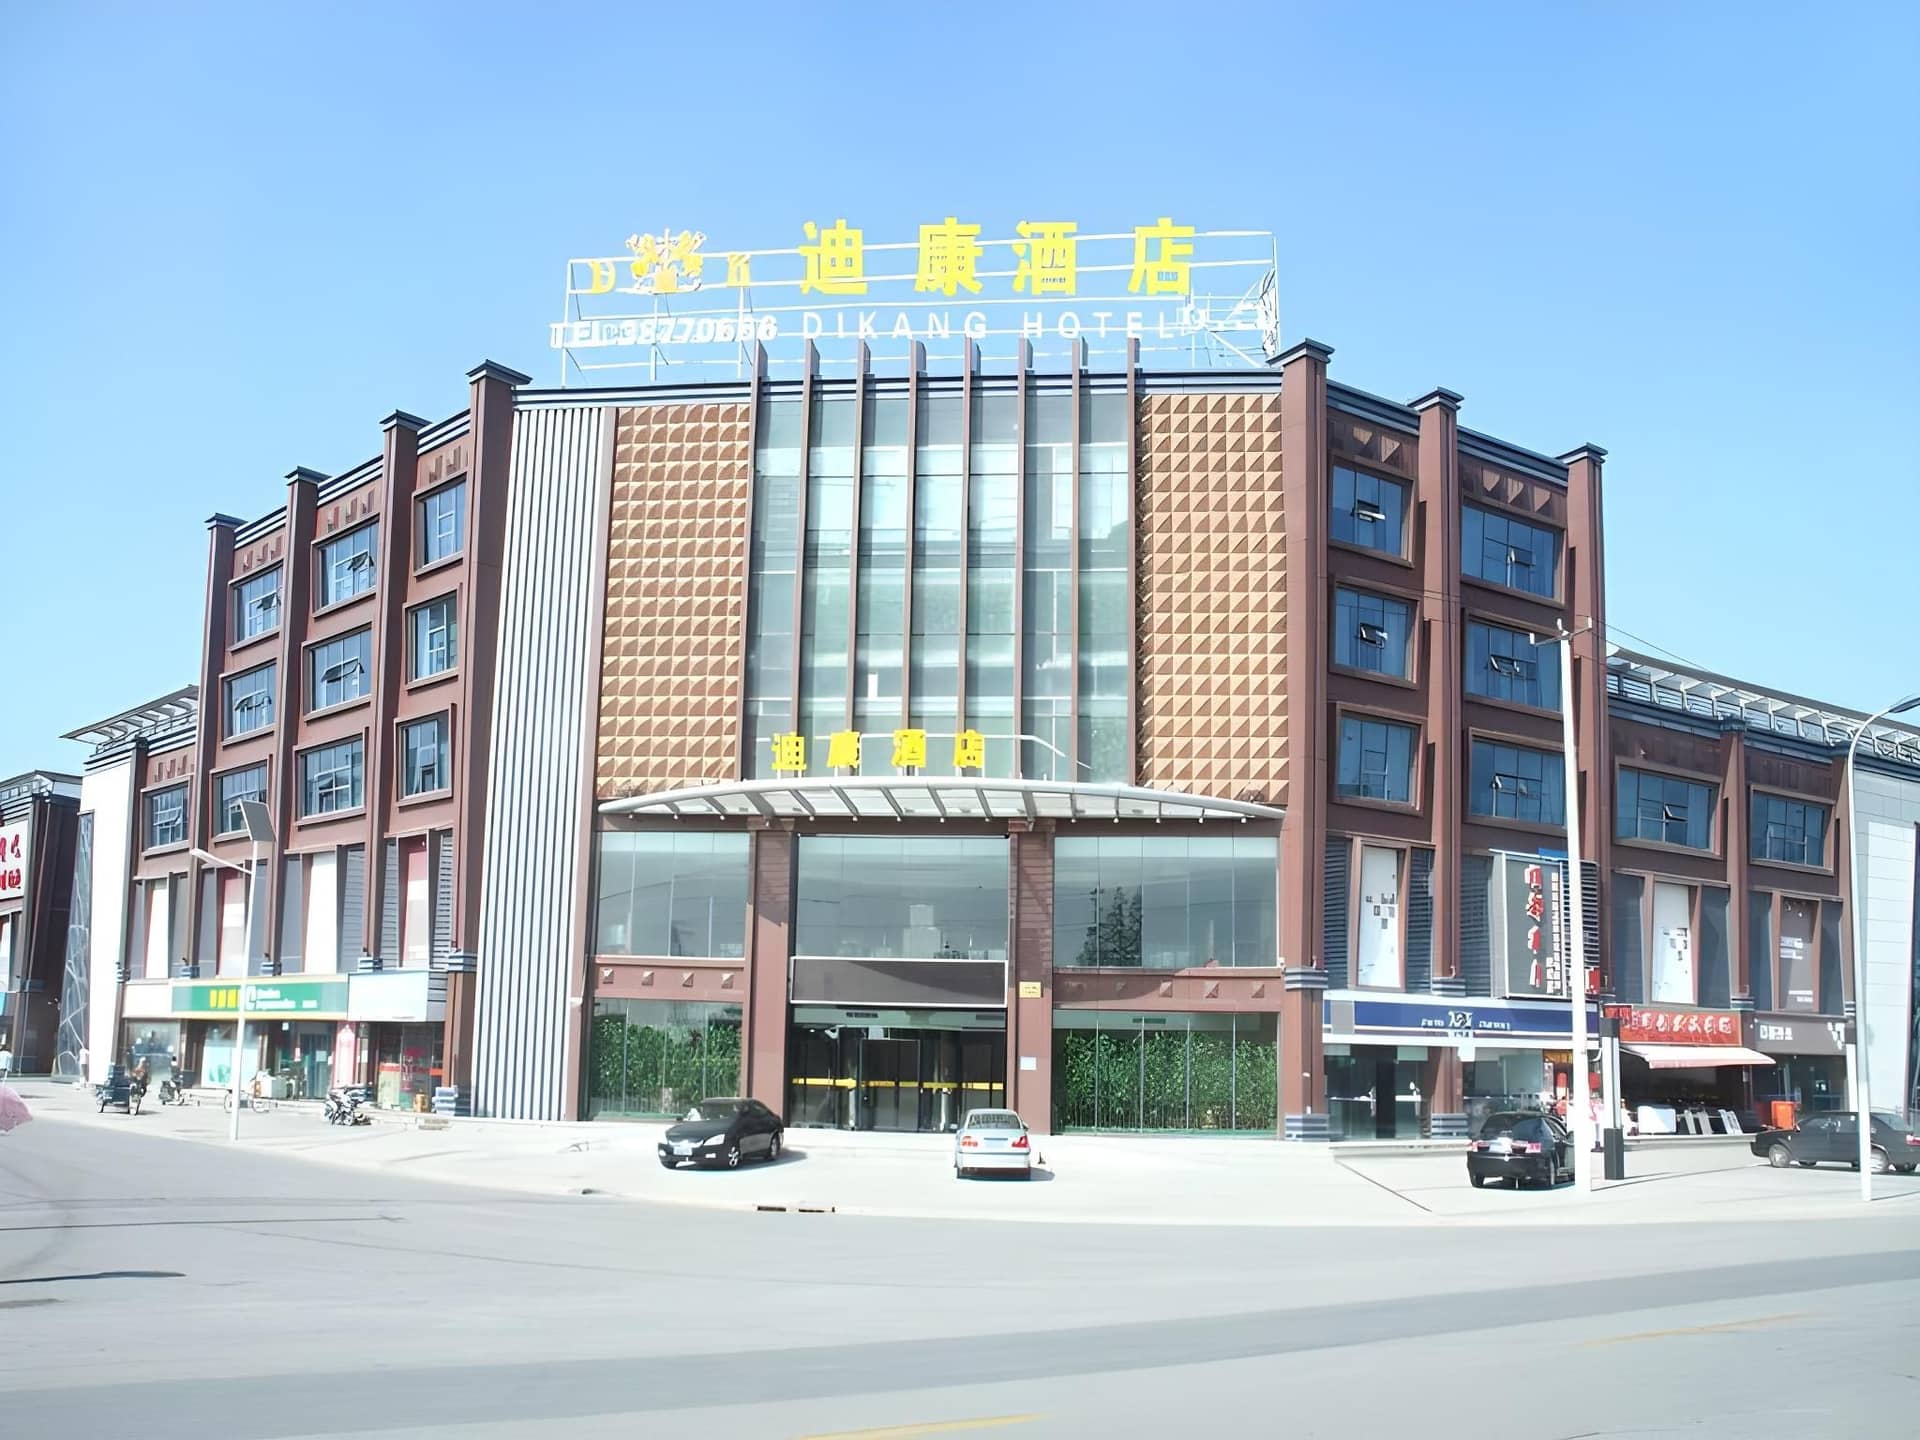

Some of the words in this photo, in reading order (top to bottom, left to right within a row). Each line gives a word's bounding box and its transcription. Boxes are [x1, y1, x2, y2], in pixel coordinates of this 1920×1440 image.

[799, 217, 1195, 297] 迪康酒店
[803, 311, 987, 339] DIKANG
[1023, 310, 1174, 339] HOTEL
